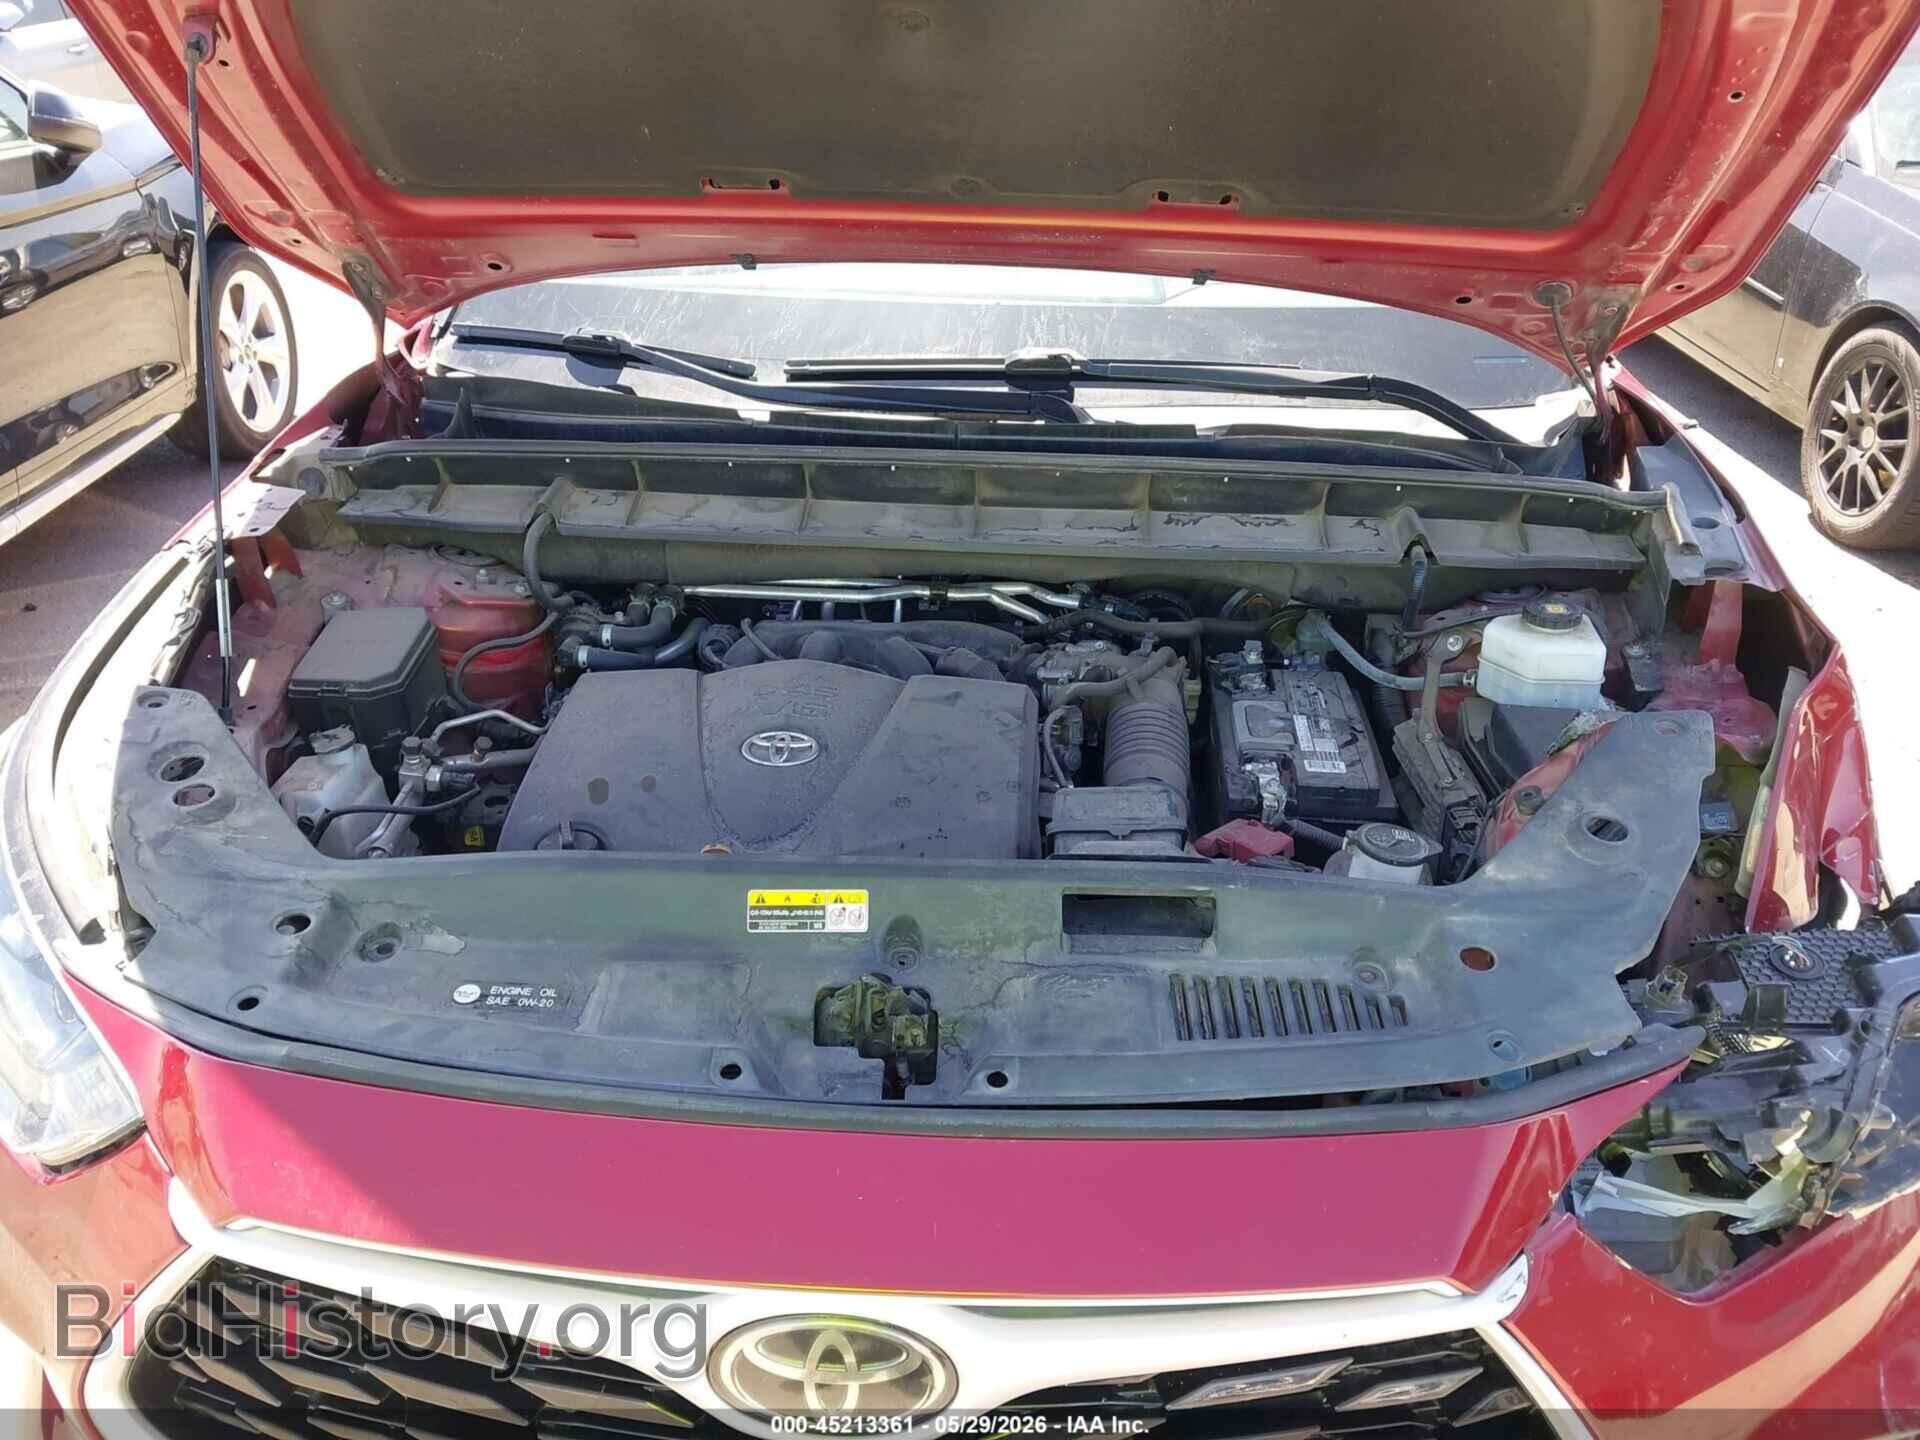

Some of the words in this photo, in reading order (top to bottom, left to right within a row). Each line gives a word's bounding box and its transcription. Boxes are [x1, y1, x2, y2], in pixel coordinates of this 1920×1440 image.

[489, 985, 533, 996] ENGINE
[539, 988, 558, 997] OIL
[486, 996, 510, 1005] SAE
[518, 998, 554, 1007] 0W-20
